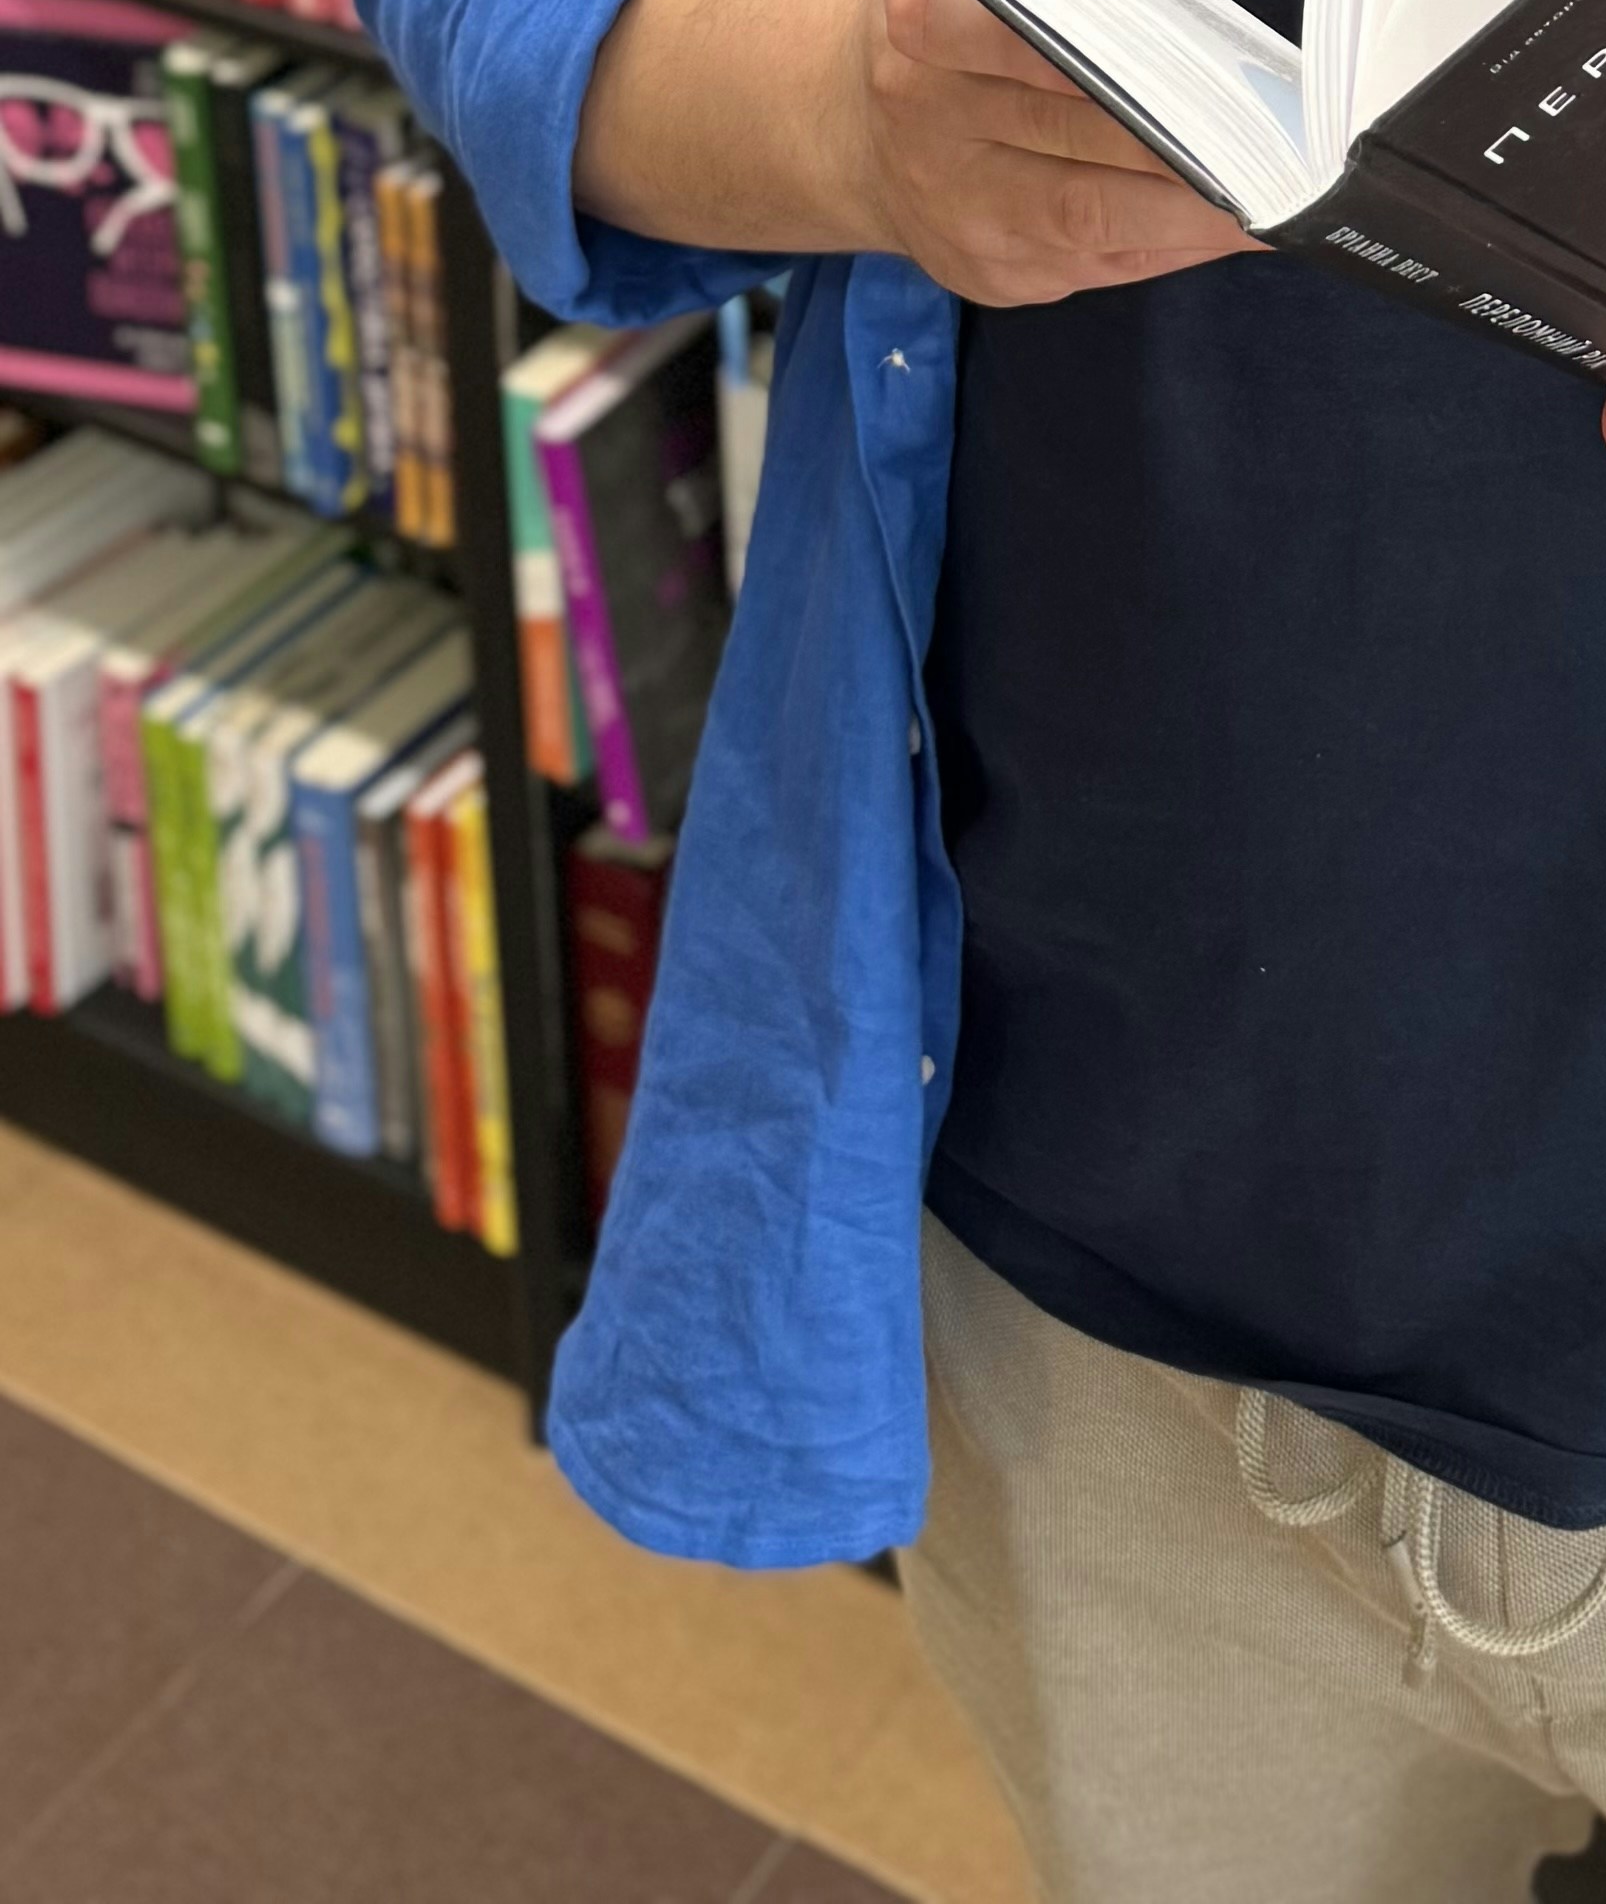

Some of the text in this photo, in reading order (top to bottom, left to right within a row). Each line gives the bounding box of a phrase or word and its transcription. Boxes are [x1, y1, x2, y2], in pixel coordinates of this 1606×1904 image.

[1489, 49, 1521, 74] Від
[1326, 227, 1400, 266] БРІАННА
[1391, 258, 1439, 282] ВЕСТ
[1459, 293, 1592, 359] ПЕРЕЛОМНИЙ
